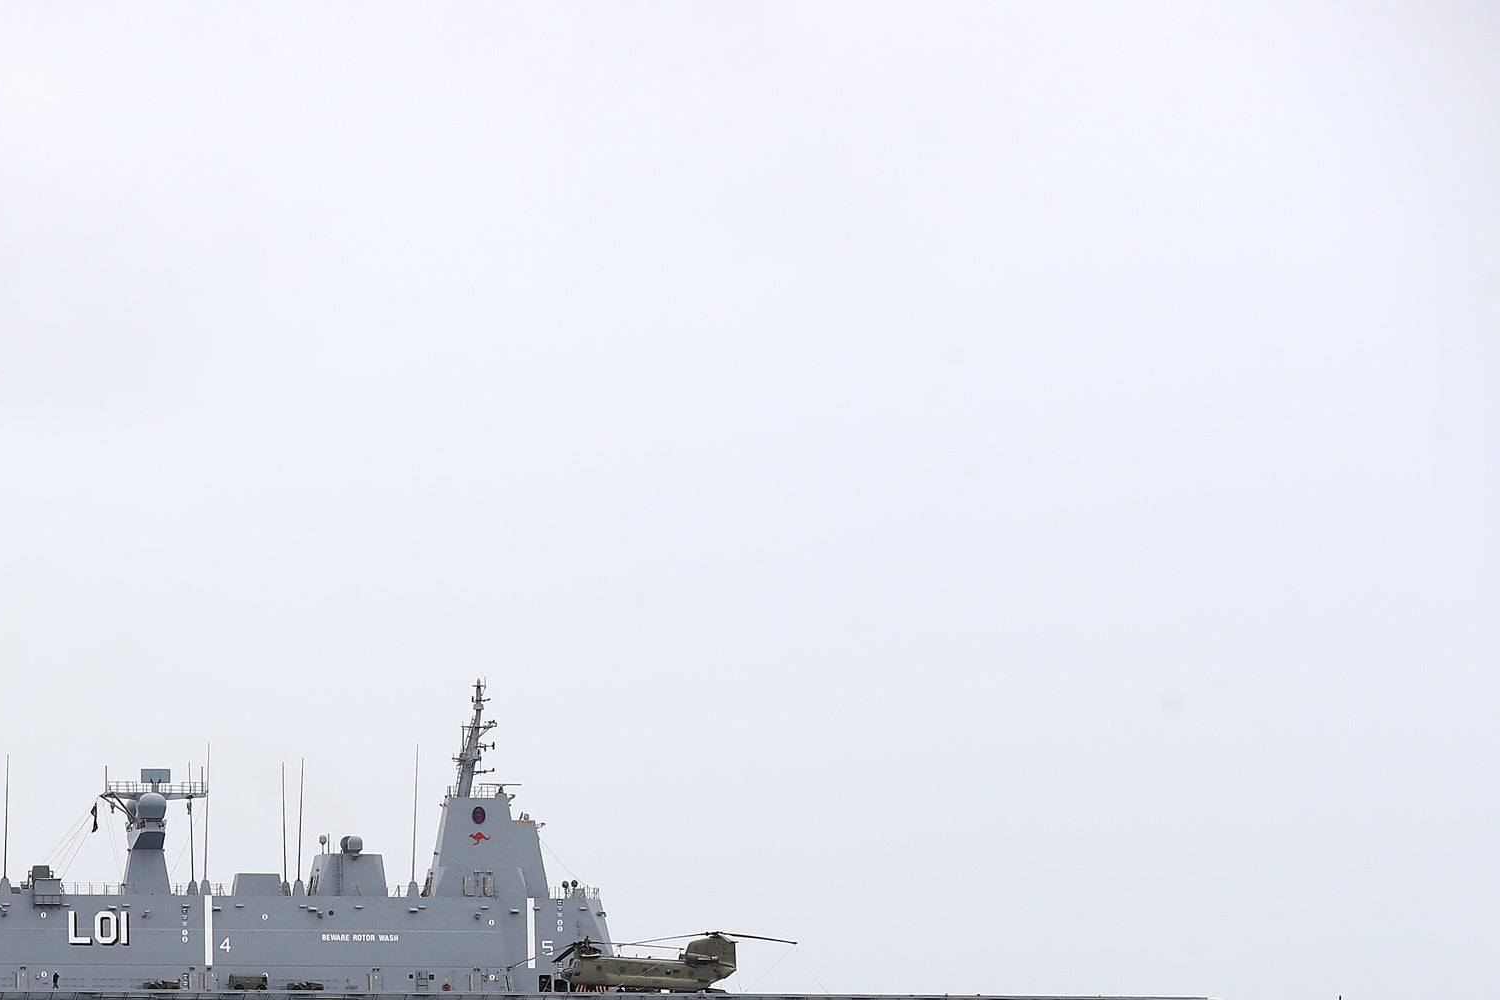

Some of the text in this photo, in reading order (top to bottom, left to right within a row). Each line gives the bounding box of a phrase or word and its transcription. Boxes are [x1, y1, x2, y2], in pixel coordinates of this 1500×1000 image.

[321, 933, 399, 942] BEWARE ROTOR WASH
[219, 938, 231, 953] 4
[541, 940, 553, 955] 5
